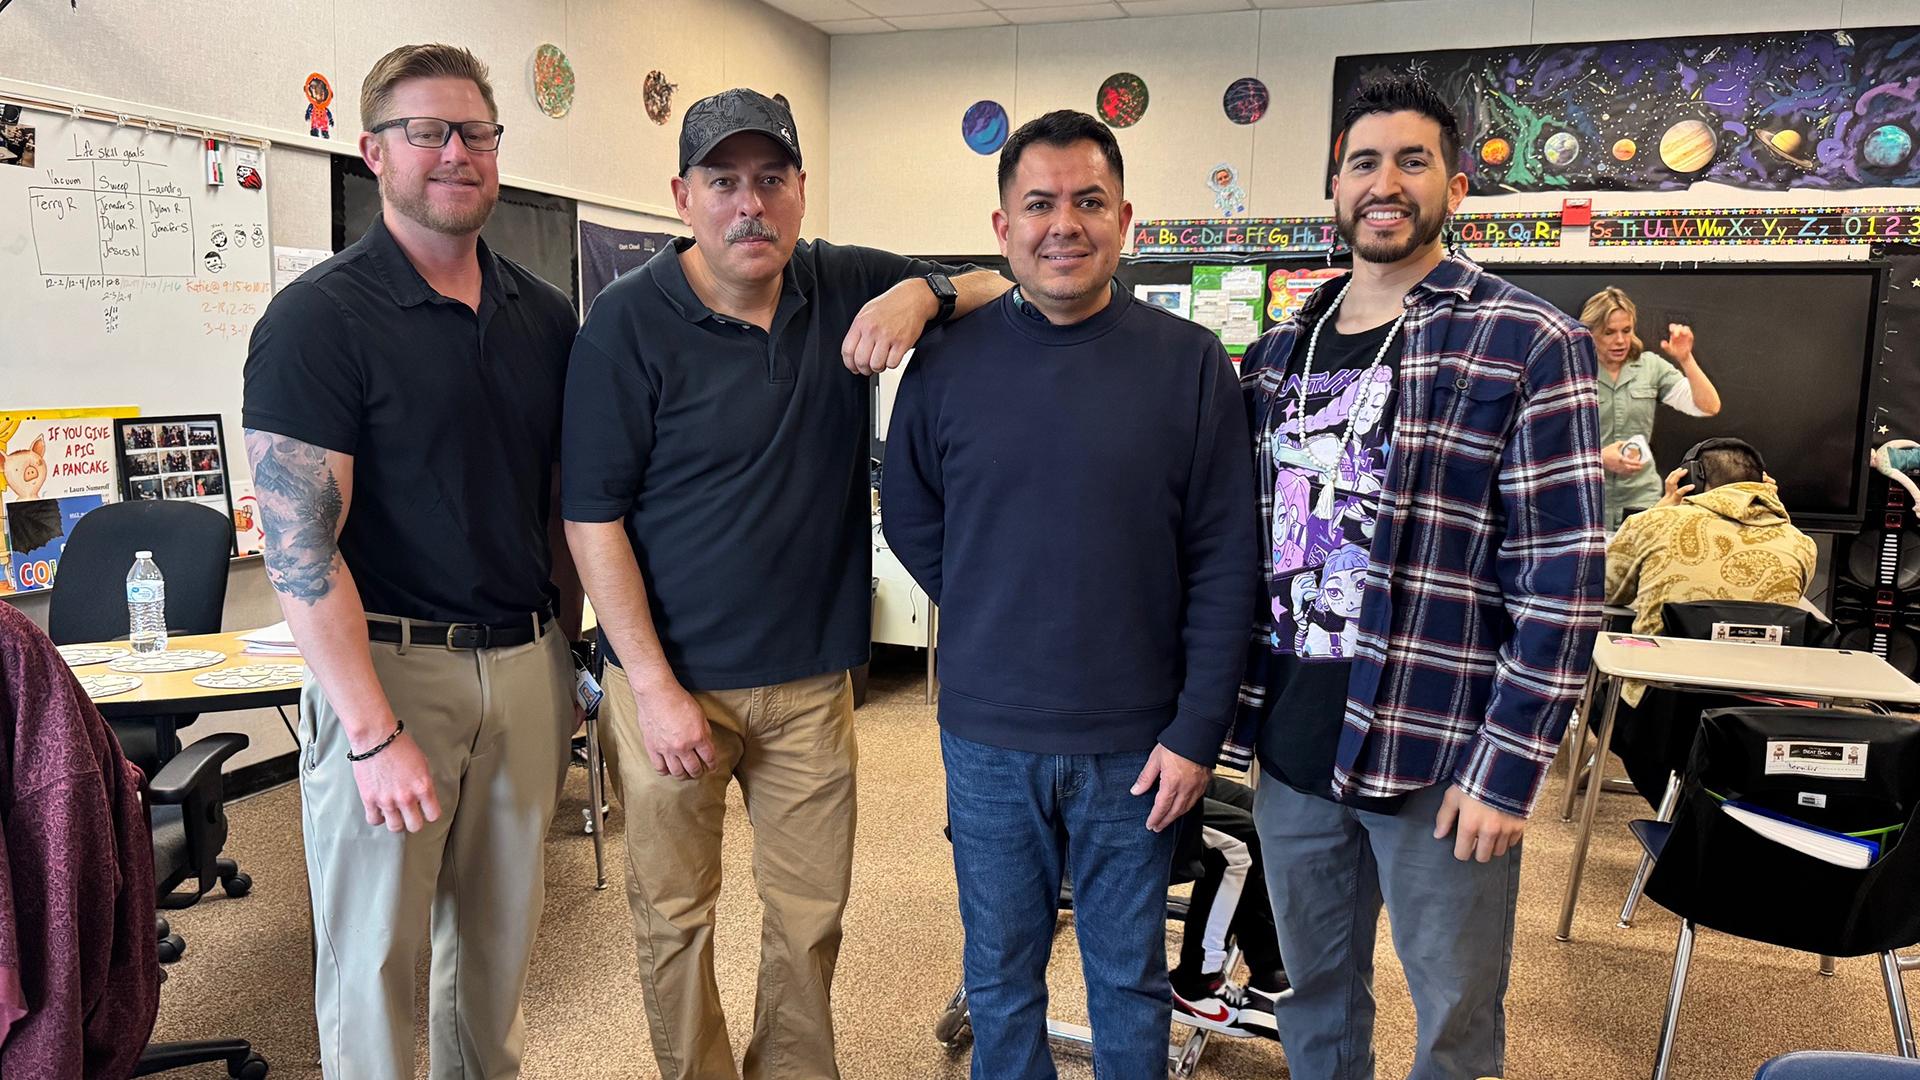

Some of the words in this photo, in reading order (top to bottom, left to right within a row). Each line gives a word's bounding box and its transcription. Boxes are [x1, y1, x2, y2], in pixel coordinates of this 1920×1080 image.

[74, 134, 93, 157] Life
[123, 146, 145, 167] goals
[46, 169, 82, 185] Vacuum
[99, 175, 129, 199] Sweep
[147, 180, 182, 196] Laundry
[30, 194, 64, 220] Terry
[66, 196, 78, 211] R
[99, 215, 127, 241] Dylan
[1135, 228, 1155, 245] Aa
[1158, 227, 1179, 246] Bb
[1180, 228, 1198, 245] Cc
[1200, 226, 1224, 245] Dd
[1225, 226, 1245, 244] Ee
[1245, 226, 1267, 245] Ff
[1268, 226, 1290, 248] Gg
[1292, 226, 1316, 244] Hh
[1461, 222, 1484, 241] Oo
[1485, 222, 1506, 243] Pp
[1508, 222, 1532, 242] Qq
[1535, 221, 1561, 240] Rr
[1591, 219, 1613, 238] Ss
[1617, 219, 1639, 238] Tt
[1643, 218, 1668, 238] Uu
[1672, 218, 1693, 237] Vv
[1696, 217, 1726, 237] Ww
[1727, 217, 1753, 237] Xx
[1761, 217, 1788, 242] Yy
[1797, 216, 1830, 237] Zz
[1866, 215, 1877, 236] 1
[1885, 215, 1901, 236] 2
[1907, 215, 1920, 236] 3
[101, 239, 126, 259] Jesus
[127, 245, 141, 257] N
[48, 426, 60, 441] IF
[62, 425, 83, 440] YOU
[84, 426, 111, 441] GIVE
[65, 444, 72, 458] A
[74, 442, 95, 458] PIG
[52, 463, 60, 477] A
[62, 460, 110, 476] PANCAKE
